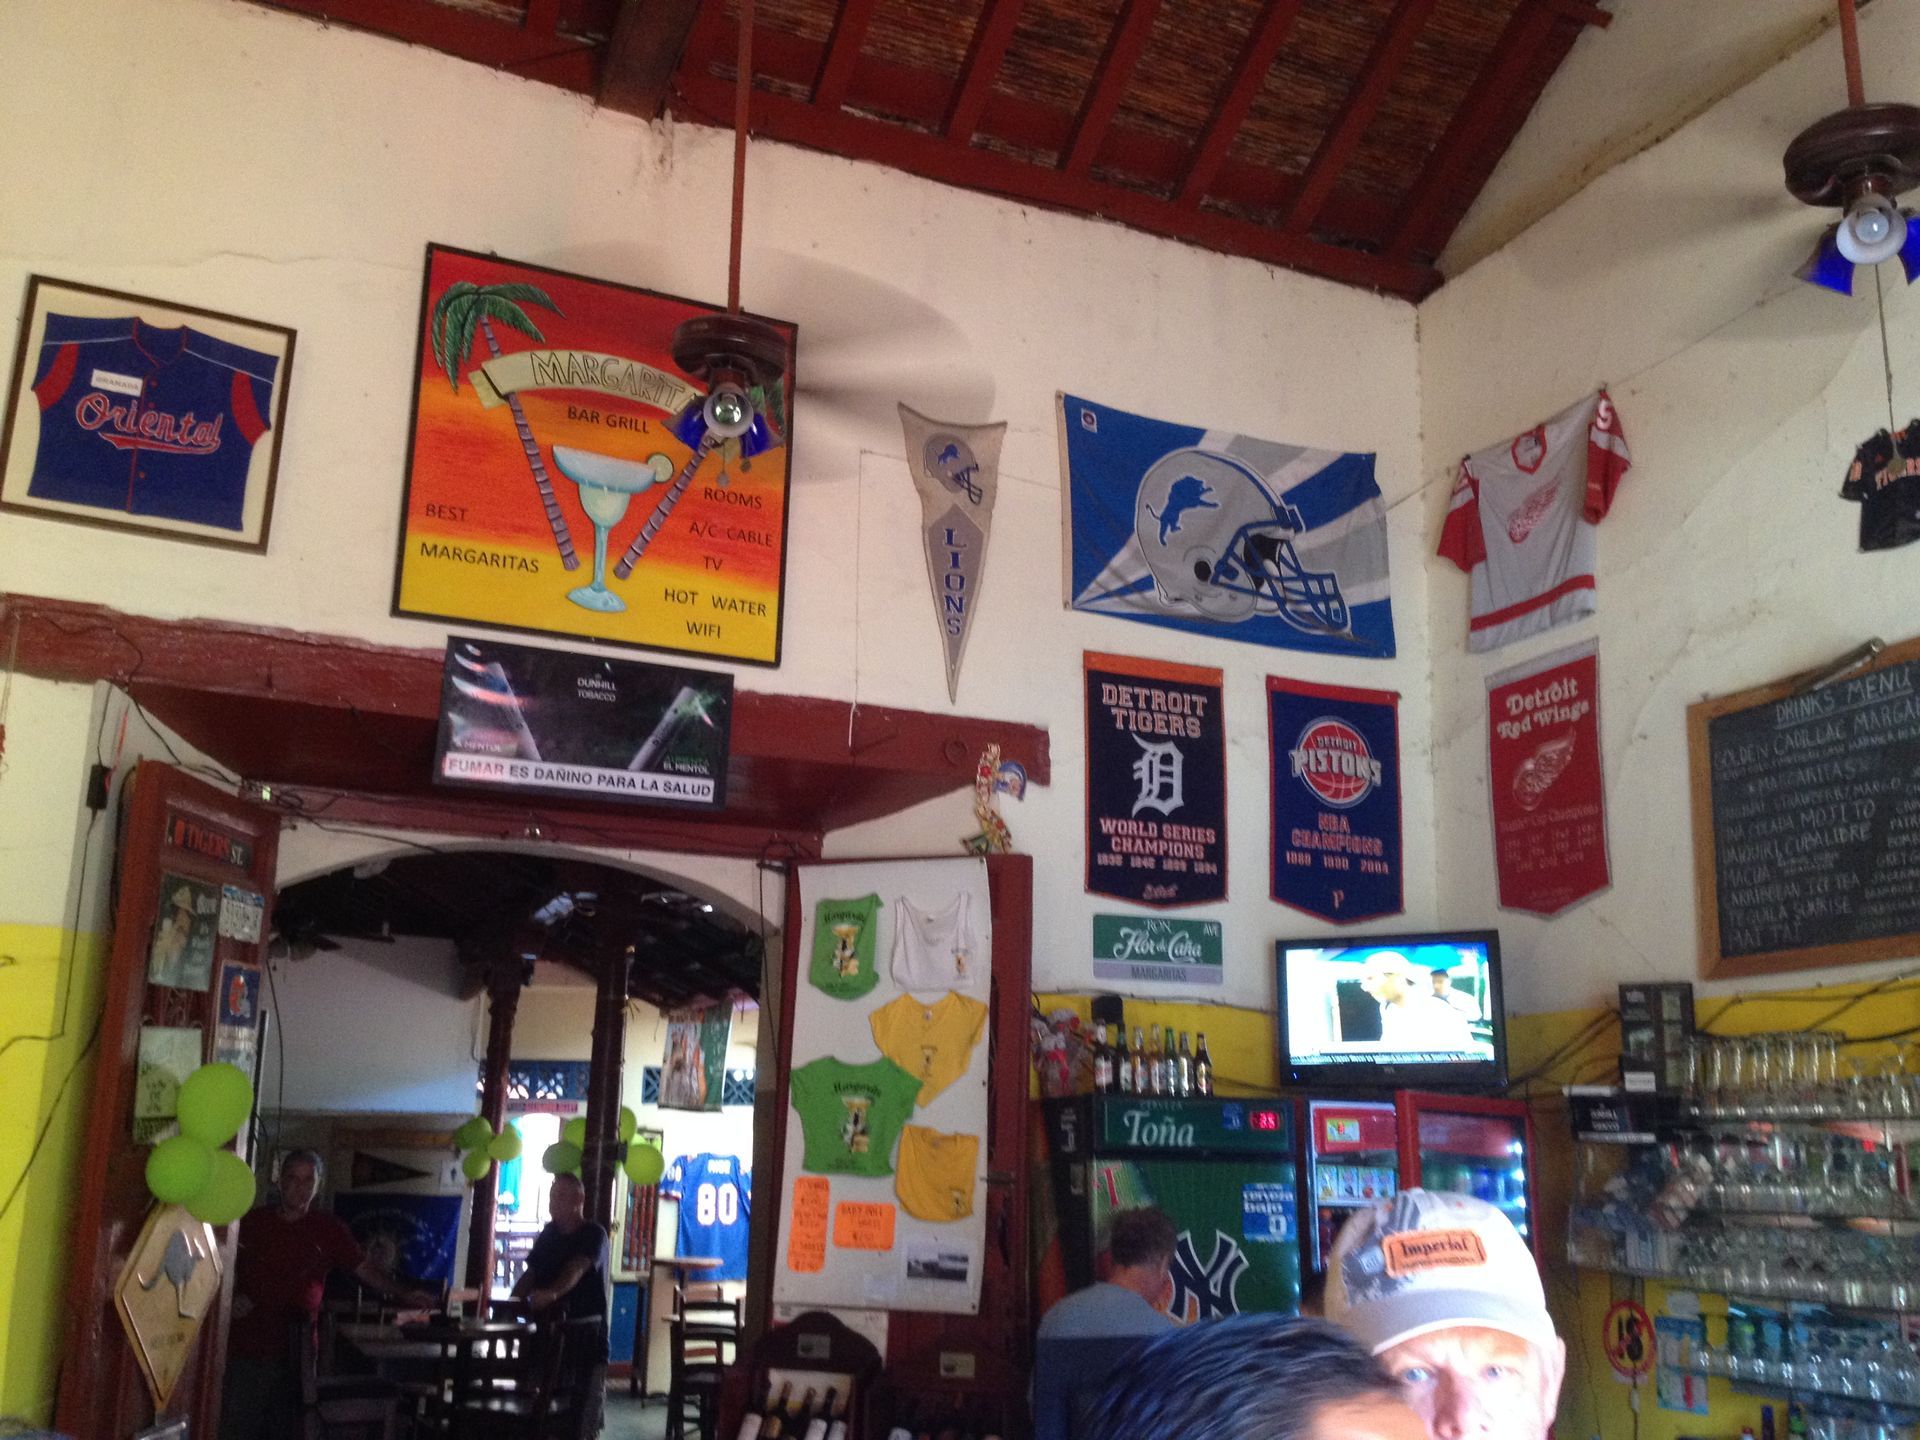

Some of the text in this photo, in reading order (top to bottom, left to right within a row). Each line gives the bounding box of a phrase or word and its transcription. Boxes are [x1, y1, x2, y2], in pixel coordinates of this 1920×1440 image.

[530, 352, 691, 412] MARGARIT
[76, 392, 223, 447] Oriental
[567, 406, 650, 434] BAR GRILL
[426, 503, 469, 521] BEST
[703, 487, 762, 510] ROOMS
[689, 521, 773, 548] A/C CABLE
[421, 542, 539, 574] MARGARITAS
[703, 555, 722, 572] TV
[664, 588, 767, 617] HOT WATER
[686, 621, 722, 639] WIFI
[1101, 683, 1207, 717] DETROIT
[1776, 667, 1912, 723] DRINKS MENU
[1111, 708, 1201, 738] TIGERS
[448, 760, 505, 774] FUMAR
[509, 765, 530, 778] ES
[597, 773, 636, 790] PARA
[641, 778, 660, 792] LA
[663, 780, 711, 797] SALUD
[1288, 749, 1381, 788] PISTONS
[1100, 818, 1215, 844] WORLD SERIES
[1112, 836, 1204, 860] CHAMPIONS
[1131, 966, 1187, 981] MARGARITAS
[1123, 1109, 1195, 1147] Toña
[697, 1182, 738, 1227] 80
[1398, 1234, 1468, 1257] Imperial
